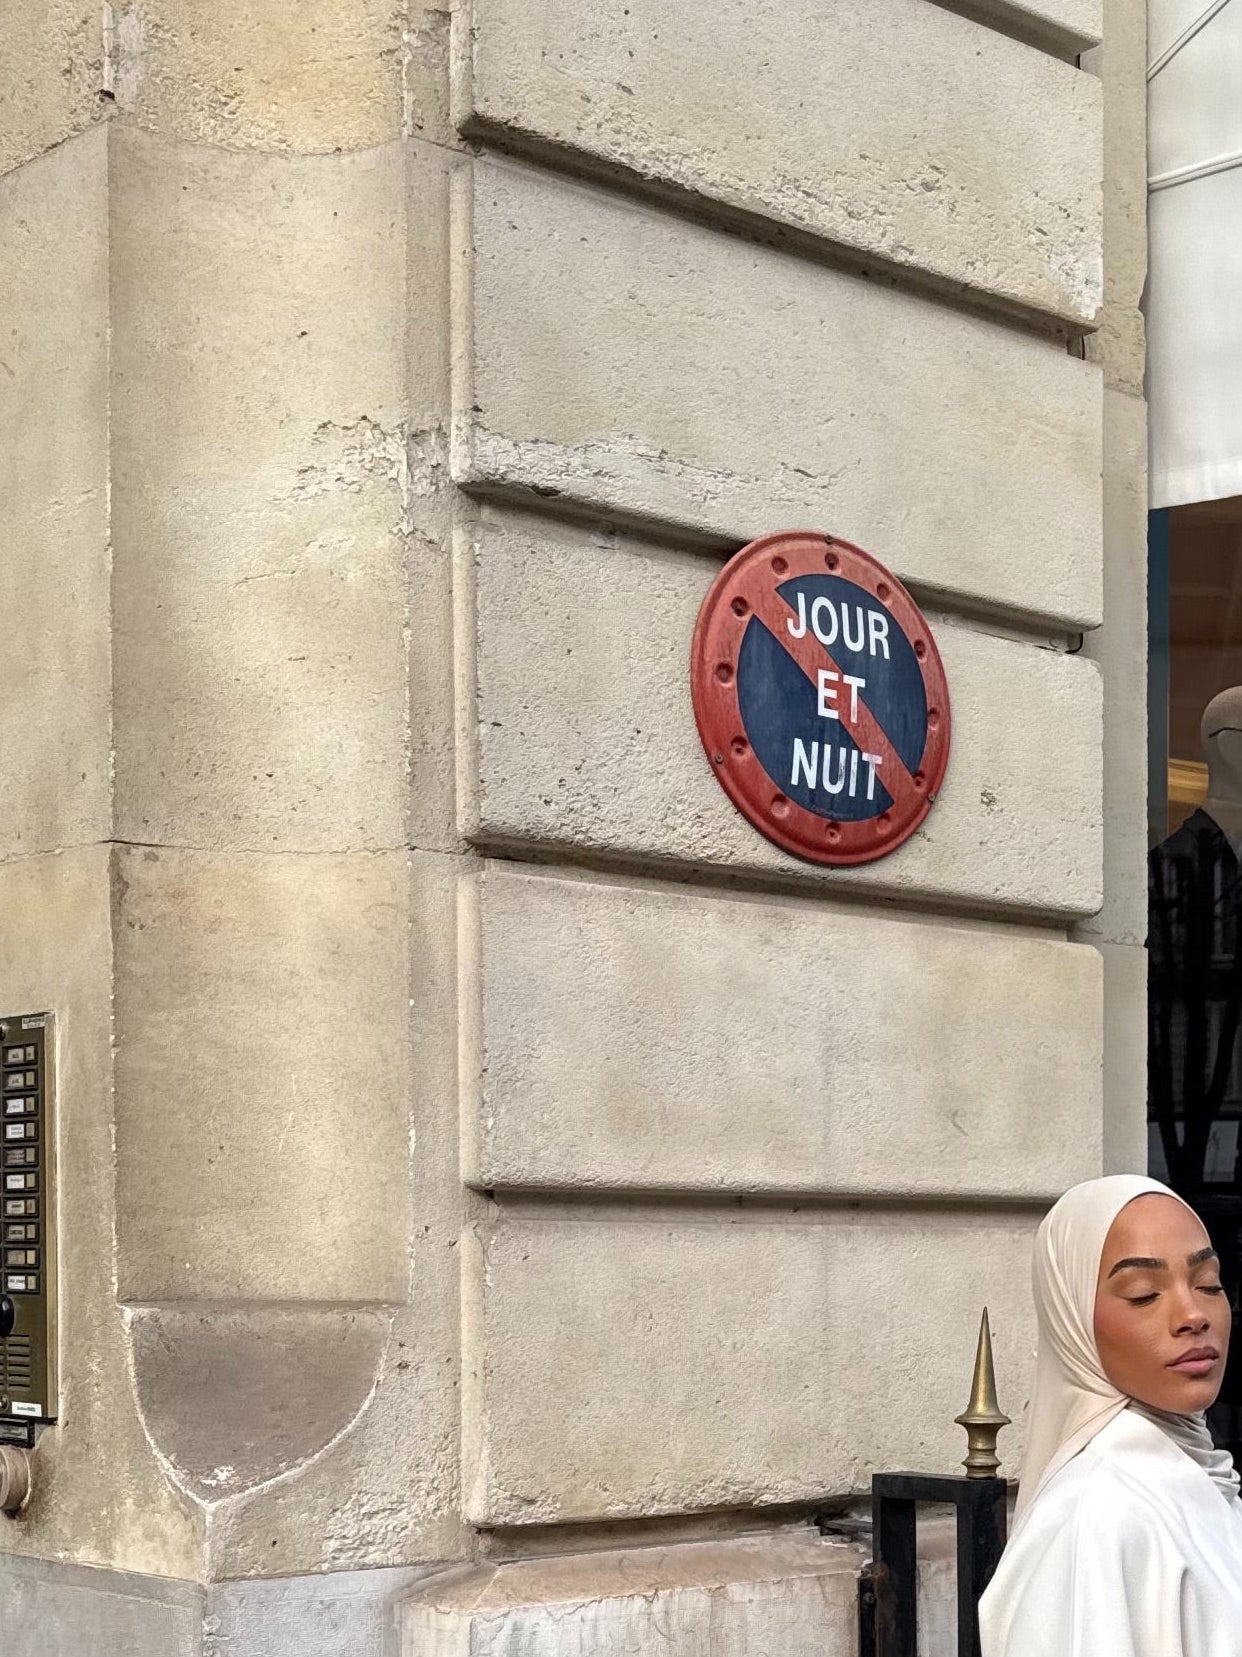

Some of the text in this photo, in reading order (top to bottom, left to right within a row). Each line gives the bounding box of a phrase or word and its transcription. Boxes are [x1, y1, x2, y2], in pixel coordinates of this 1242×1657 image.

[787, 592, 890, 659] JOUR
[817, 669, 865, 723] ET
[791, 738, 882, 800] NUIT
